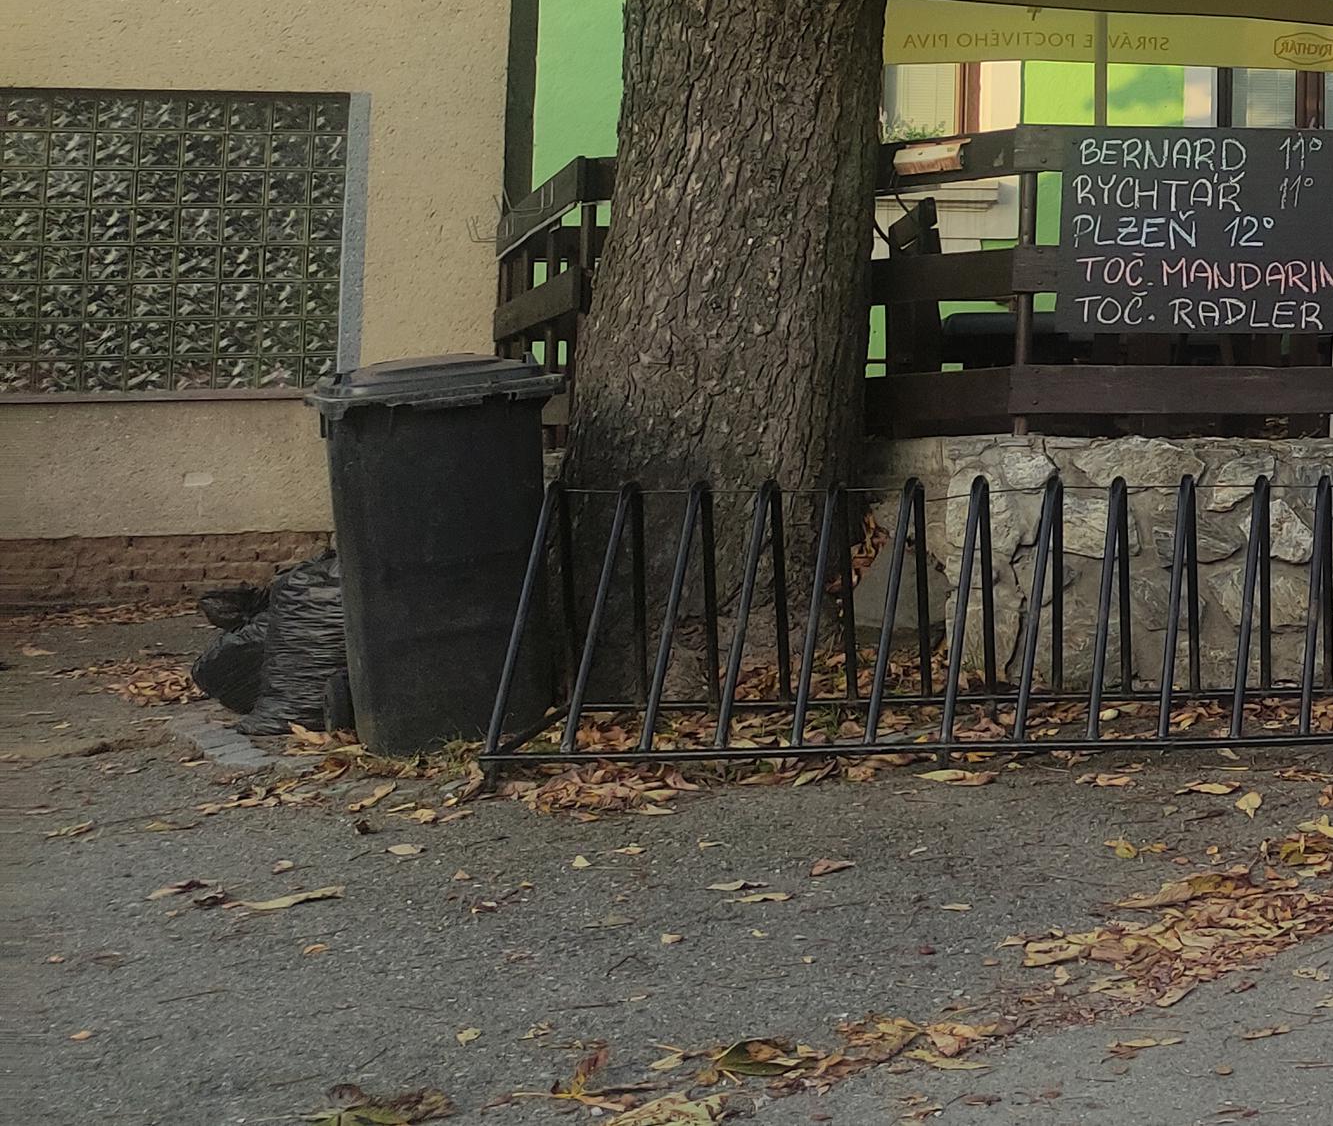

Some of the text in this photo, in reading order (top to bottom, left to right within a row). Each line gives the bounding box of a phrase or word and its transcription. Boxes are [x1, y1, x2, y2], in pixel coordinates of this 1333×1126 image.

[1080, 137, 1248, 171] BERNARD
[1072, 171, 1246, 213] RYCHTÁŘ
[1072, 210, 1196, 250] PLZEŇ
[1076, 252, 1154, 288] TOČ.
[1074, 290, 1324, 331] TOČ. RADLER
